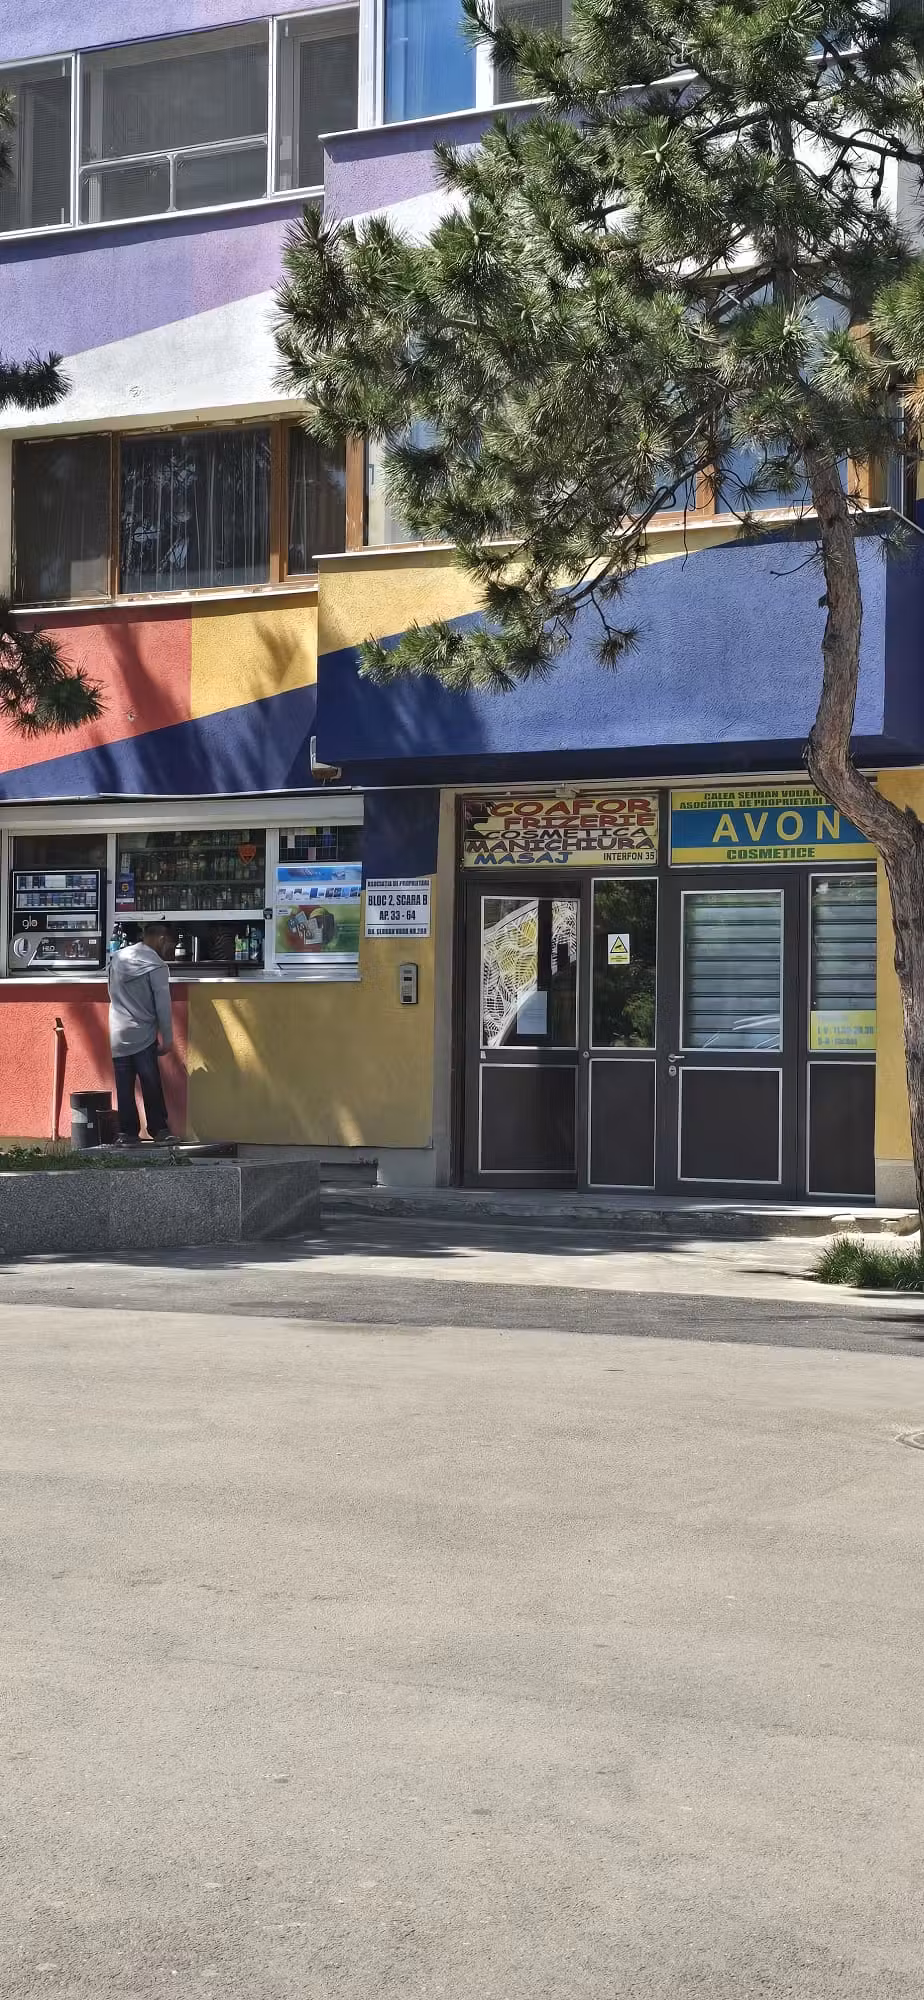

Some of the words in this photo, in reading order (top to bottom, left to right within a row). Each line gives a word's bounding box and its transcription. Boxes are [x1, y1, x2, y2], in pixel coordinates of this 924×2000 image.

[704, 792, 735, 800] CALEA
[738, 791, 780, 799] SERBAN
[781, 789, 811, 798] VODA
[490, 799, 652, 817] COAFOR
[679, 800, 735, 809] ASOCIATIA
[739, 799, 754, 807] DE
[754, 797, 823, 807] PROPRIETARI
[504, 813, 655, 829] FRIZERIE
[712, 810, 841, 843] AVON
[484, 828, 648, 840] COSMETICA
[467, 838, 655, 852] MANICHIURA
[474, 852, 571, 864] MASAJ
[603, 851, 643, 861] INTERFON
[645, 851, 655, 860] 35
[726, 847, 816, 860] COSMETICE
[368, 894, 387, 906] BLOC
[396, 894, 421, 906] SCARA
[423, 895, 428, 905] B
[379, 910, 390, 921] AP.
[390, 910, 400, 921] 33
[406, 910, 416, 921] 64
[22, 915, 38, 930] glo
